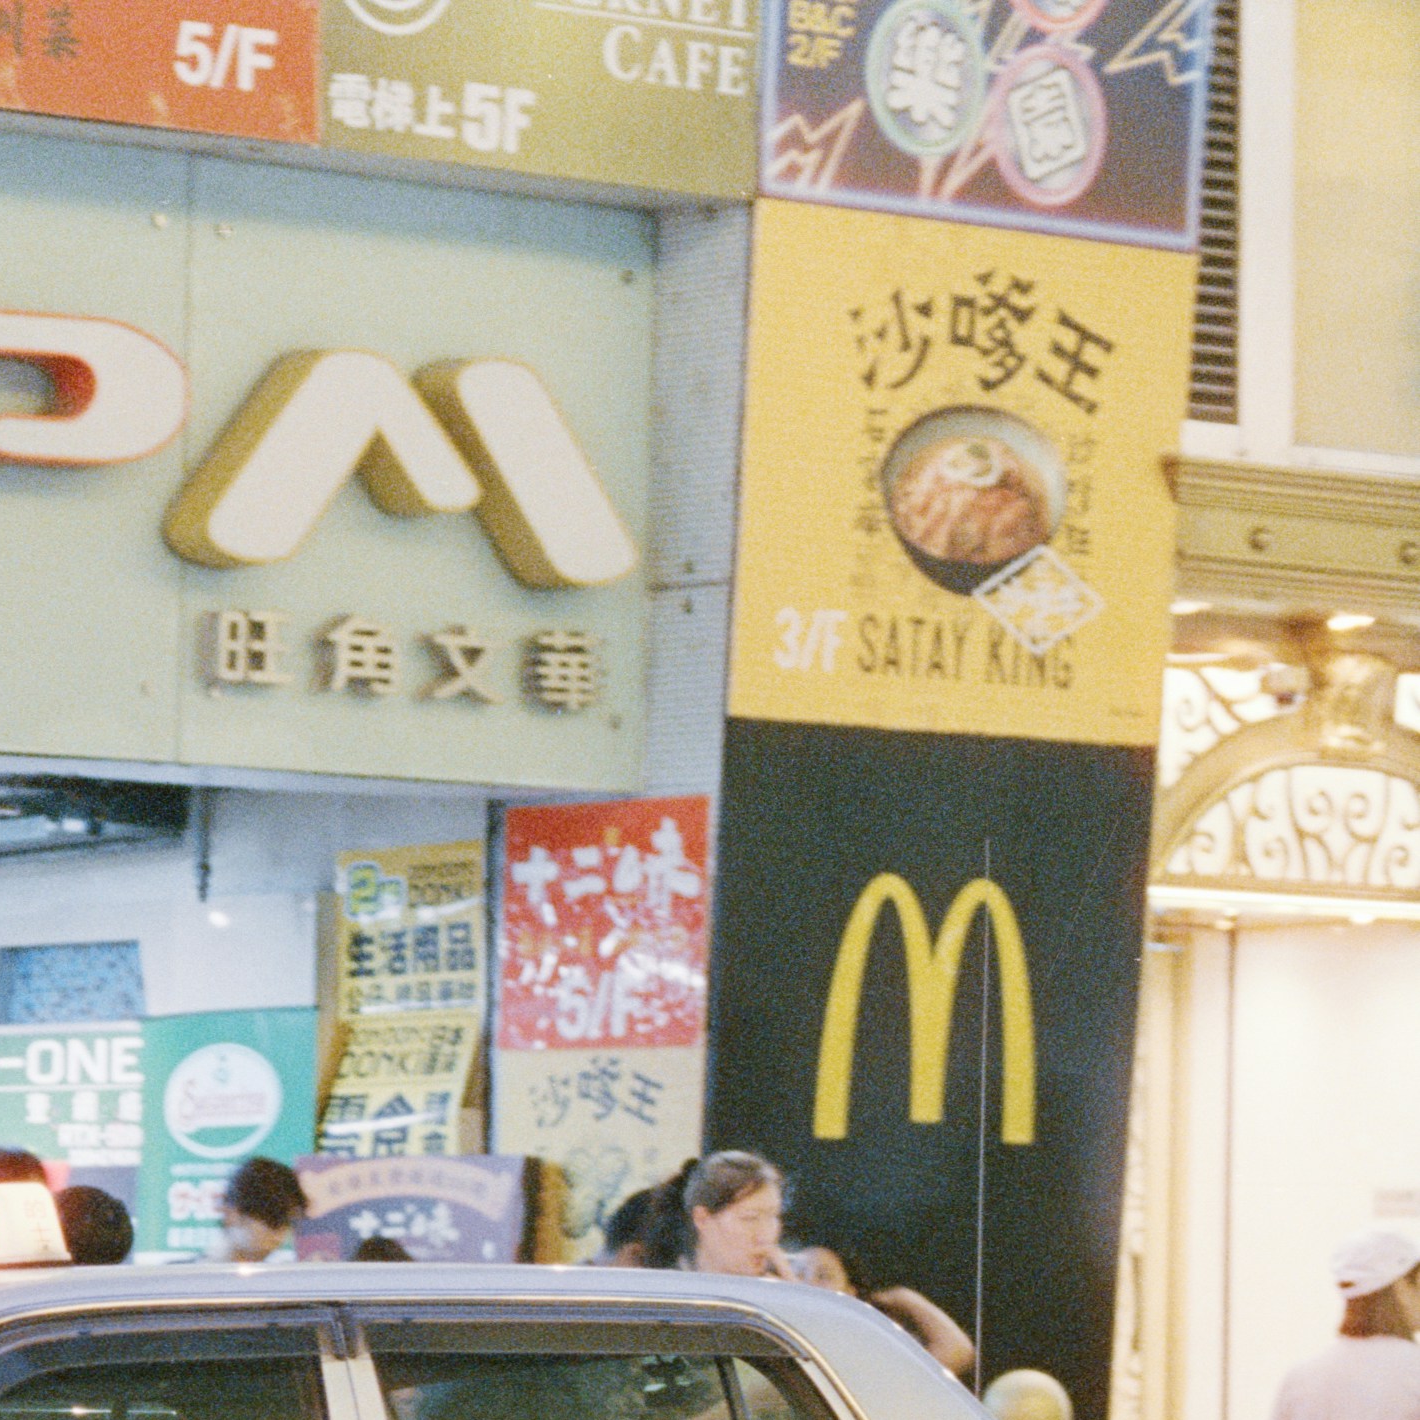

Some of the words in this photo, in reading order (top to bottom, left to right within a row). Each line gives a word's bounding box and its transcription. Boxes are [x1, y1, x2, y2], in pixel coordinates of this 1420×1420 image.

[171, 18, 280, 92] 5/F
[602, 24, 749, 96] CAFE
[772, 606, 849, 672] 3/F
[857, 611, 973, 682] SATAY
[982, 618, 1081, 691] KING
